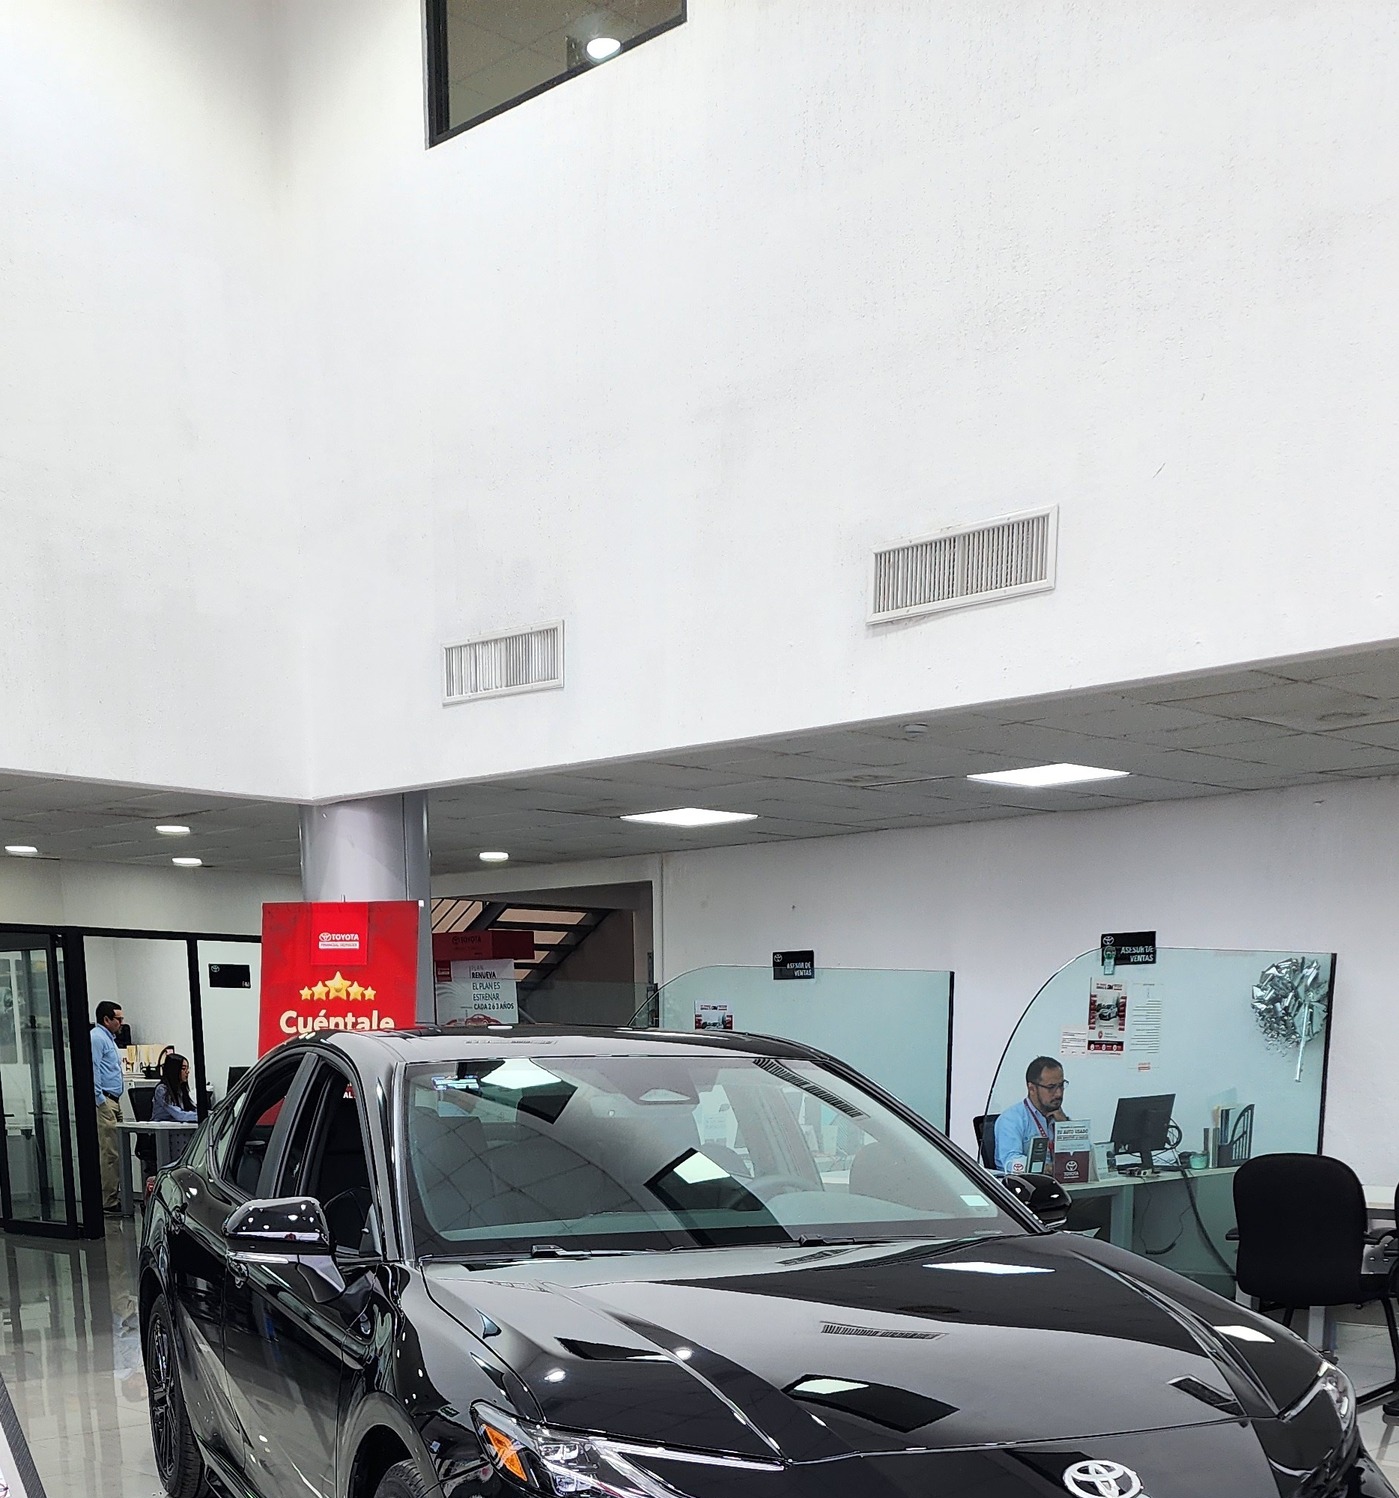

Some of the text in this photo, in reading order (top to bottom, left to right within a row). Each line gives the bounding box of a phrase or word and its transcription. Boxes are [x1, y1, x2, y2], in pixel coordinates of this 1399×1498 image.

[479, 982, 493, 990] PLAN
[494, 982, 500, 990] ES
[473, 993, 500, 1001] ESTRENAR
[500, 1002, 514, 1010] AÑOS
[280, 1009, 395, 1034] Cuéntale
